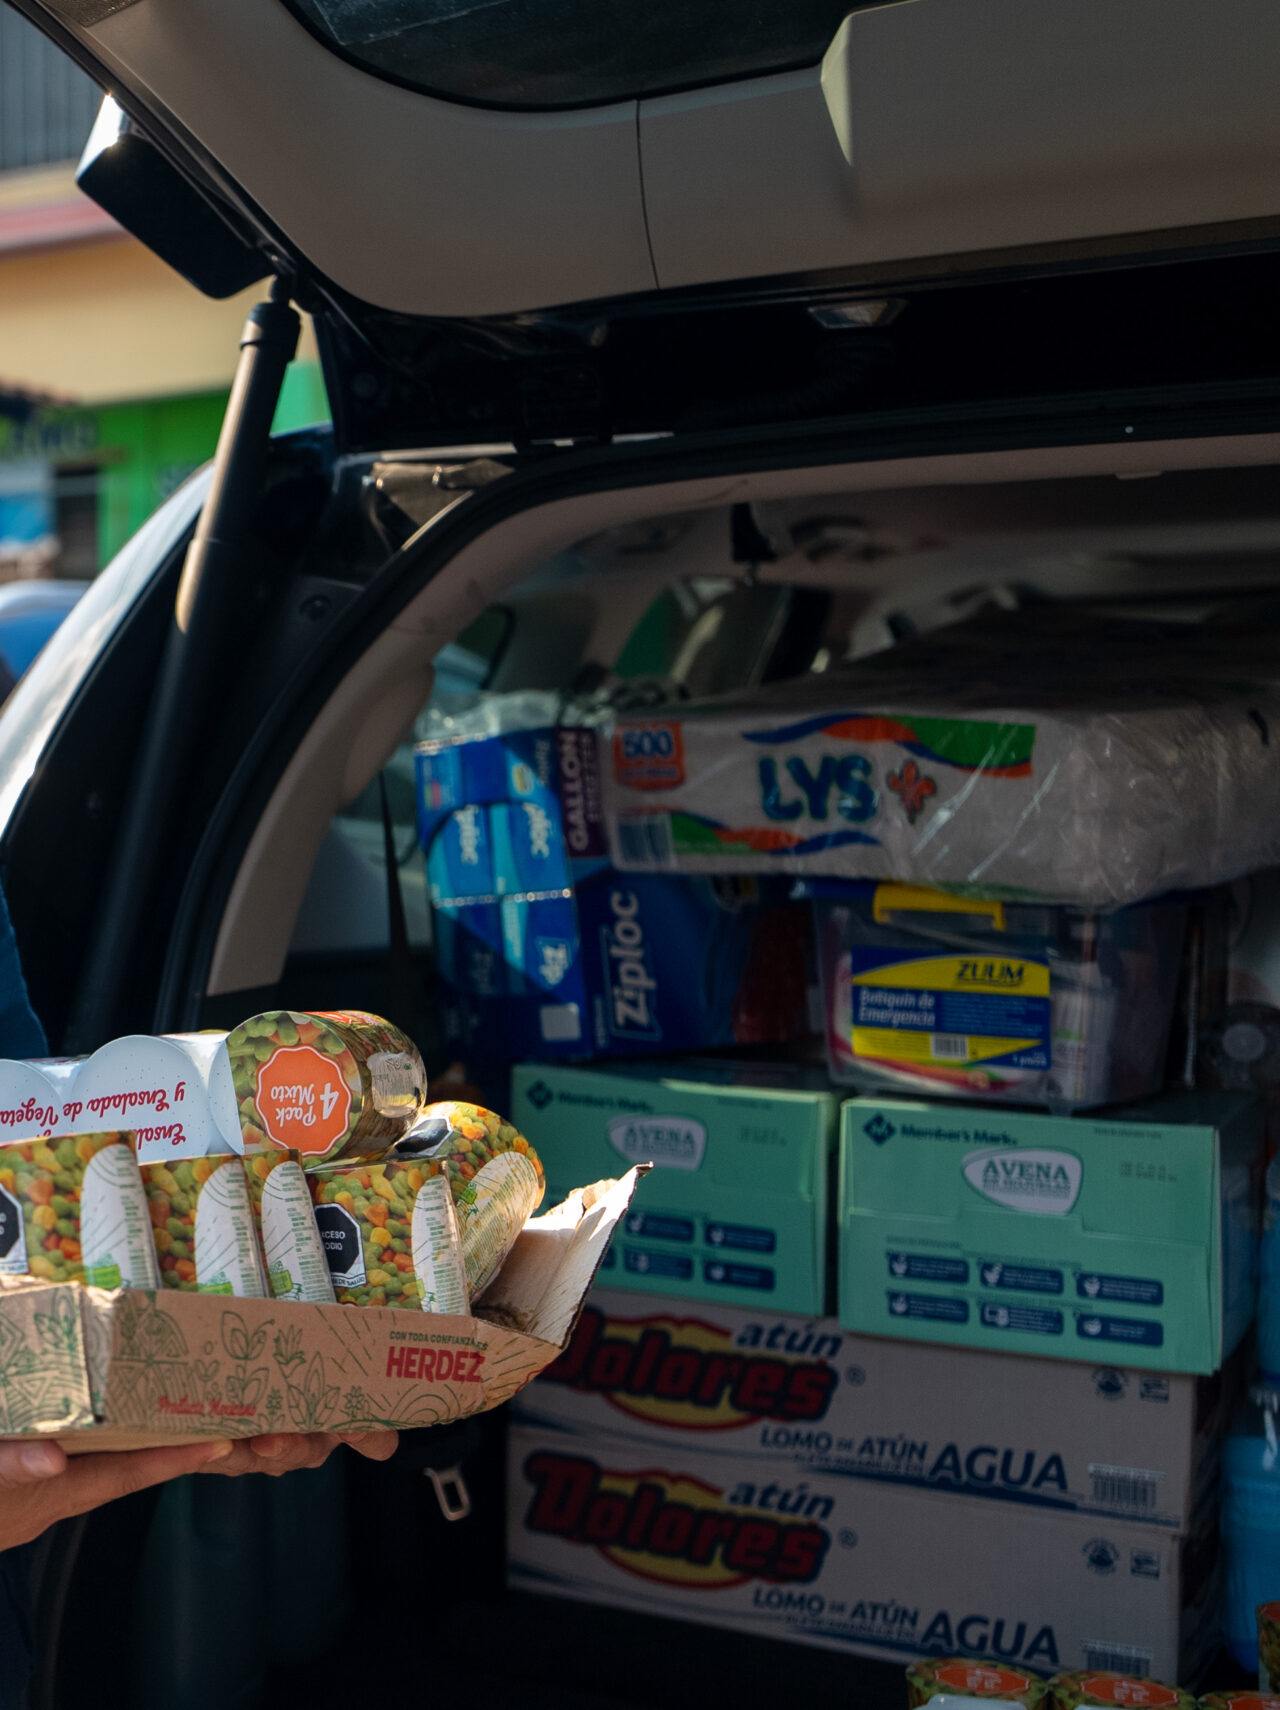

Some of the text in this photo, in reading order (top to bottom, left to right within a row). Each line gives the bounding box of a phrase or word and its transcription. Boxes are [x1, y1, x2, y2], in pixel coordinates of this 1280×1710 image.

[759, 755, 877, 821] LYS
[609, 890, 659, 1028] Ziploc
[957, 962, 1024, 981] ZUUM
[87, 1088, 170, 1117] Ensalada
[174, 1081, 186, 1102] y
[271, 1083, 315, 1106] Mixto
[320, 1082, 339, 1120] 4
[63, 1102, 83, 1122] de
[275, 1105, 317, 1128] Pack
[136, 1122, 186, 1150] Ensal
[902, 1123, 970, 1142] Member's
[984, 1160, 1069, 1181] AVENA
[322, 1230, 346, 1240] CESO
[325, 1242, 343, 1251] ODIO
[389, 1330, 406, 1340] CON
[407, 1331, 428, 1341] TODA
[430, 1333, 475, 1346] CONFIANZA
[737, 1321, 843, 1358] atún
[385, 1345, 485, 1382] HERDEZ
[761, 1428, 832, 1449] LOMO
[858, 1434, 927, 1461] ATÚN
[930, 1442, 1067, 1491] AGUA
[730, 1482, 835, 1519] atún
[525, 1450, 830, 1583] Dolores
[753, 1588, 825, 1614] LOMO
[851, 1600, 918, 1627] ATÚN
[921, 1610, 1059, 1663] AGUA
